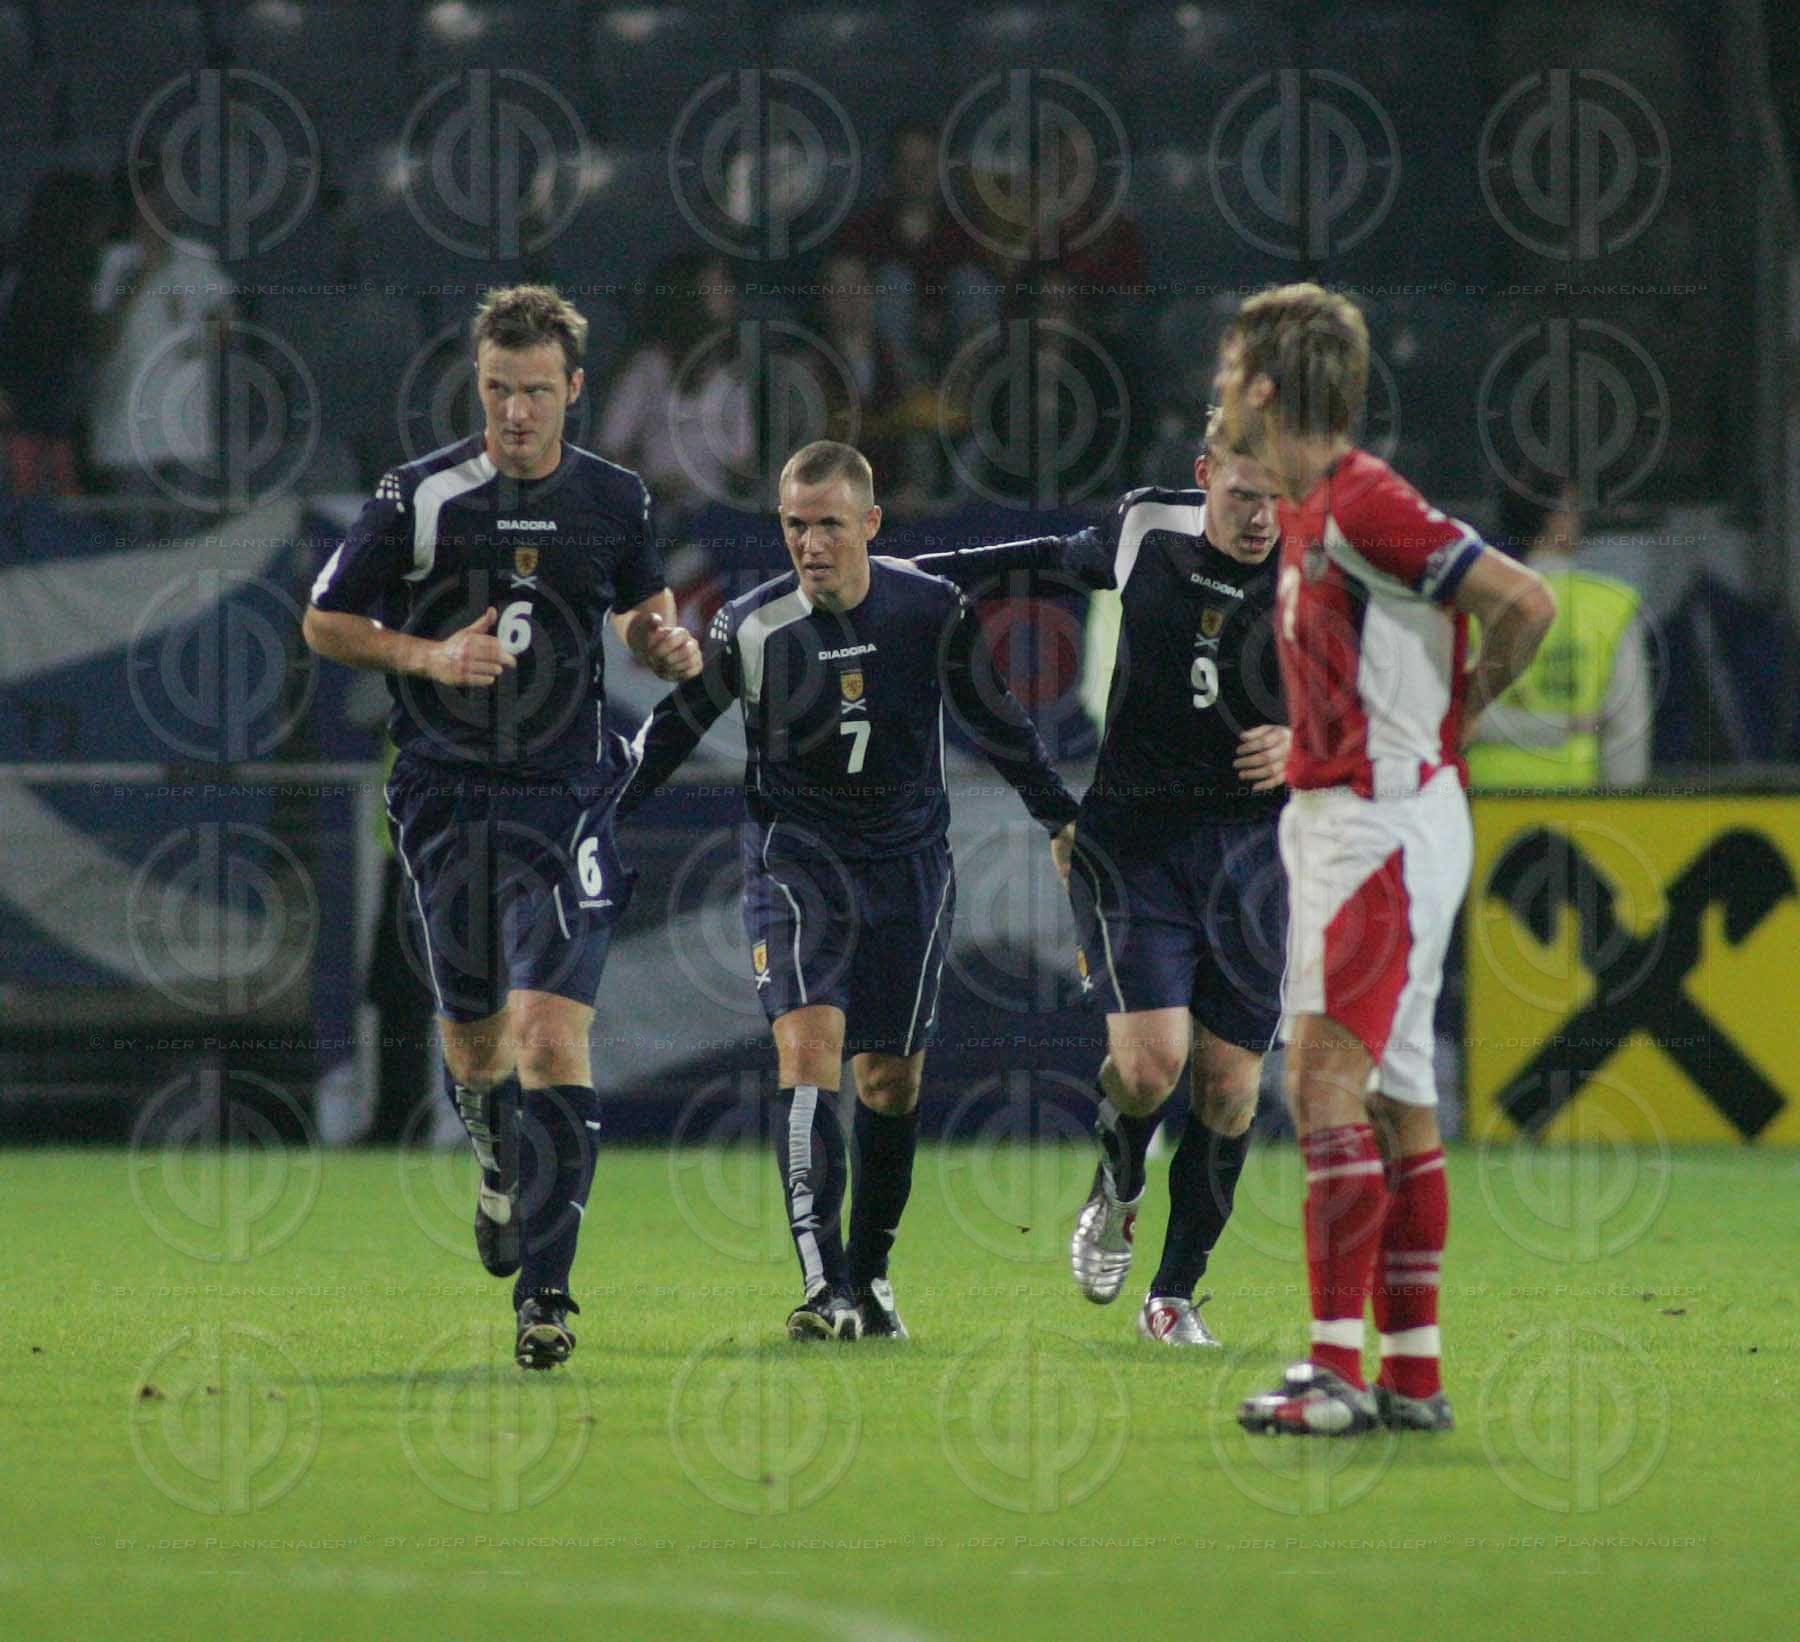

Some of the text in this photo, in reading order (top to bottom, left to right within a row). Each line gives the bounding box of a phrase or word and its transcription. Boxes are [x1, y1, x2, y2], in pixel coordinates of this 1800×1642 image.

[496, 520, 558, 530] DIADORA
[1190, 573, 1244, 599] DIADORA
[497, 601, 534, 656] 6
[818, 643, 878, 660] DIADORA
[1190, 657, 1219, 709] 9
[840, 720, 871, 773] 7
[577, 836, 603, 897] 6
